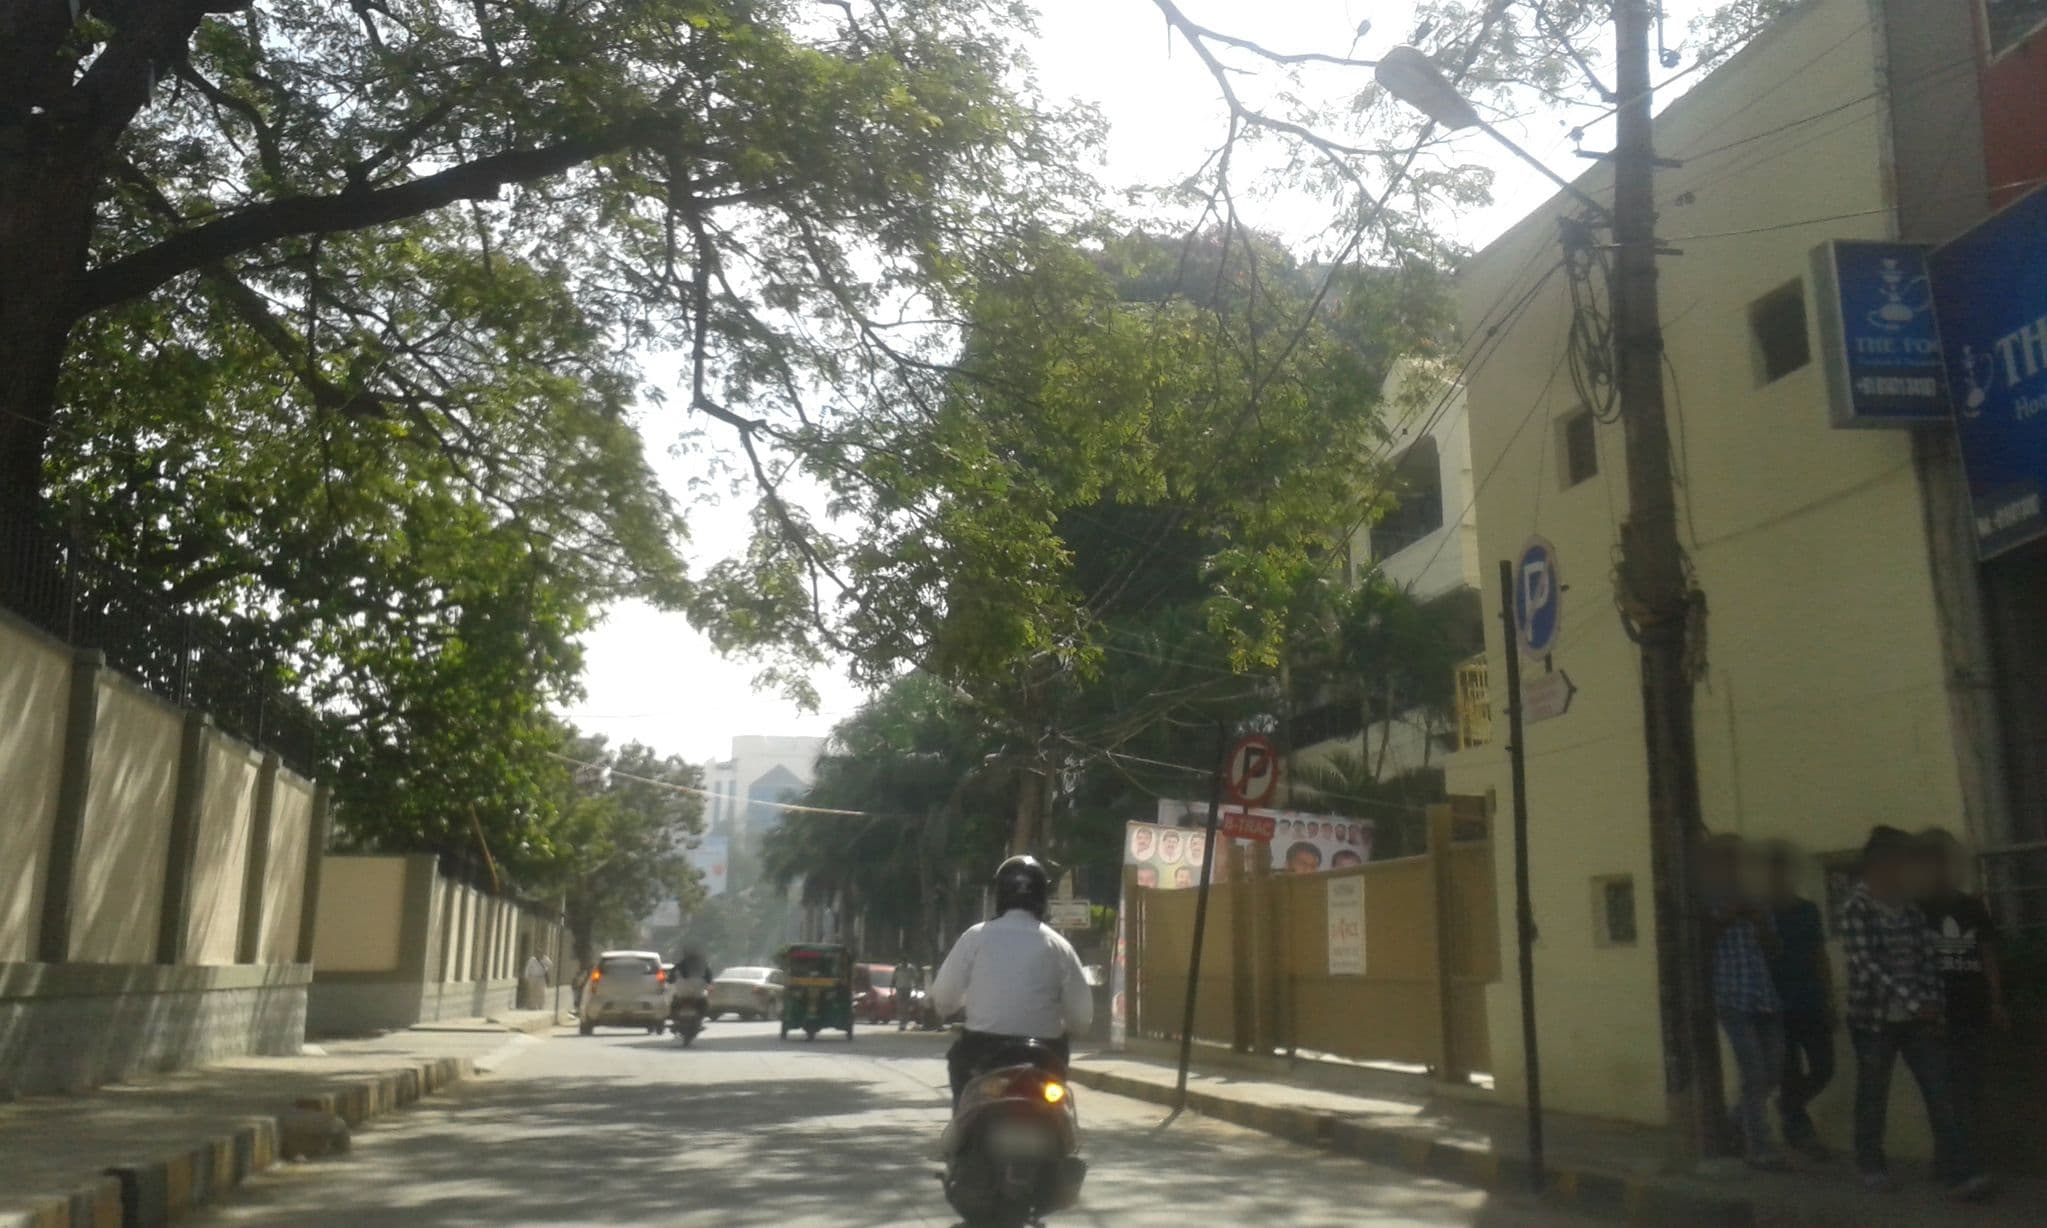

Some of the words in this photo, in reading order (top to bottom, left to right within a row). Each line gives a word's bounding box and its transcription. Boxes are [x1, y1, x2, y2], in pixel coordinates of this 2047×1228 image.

[1855, 335, 1895, 354] THE
[1523, 560, 1549, 642] P
[1242, 746, 1268, 796] P
